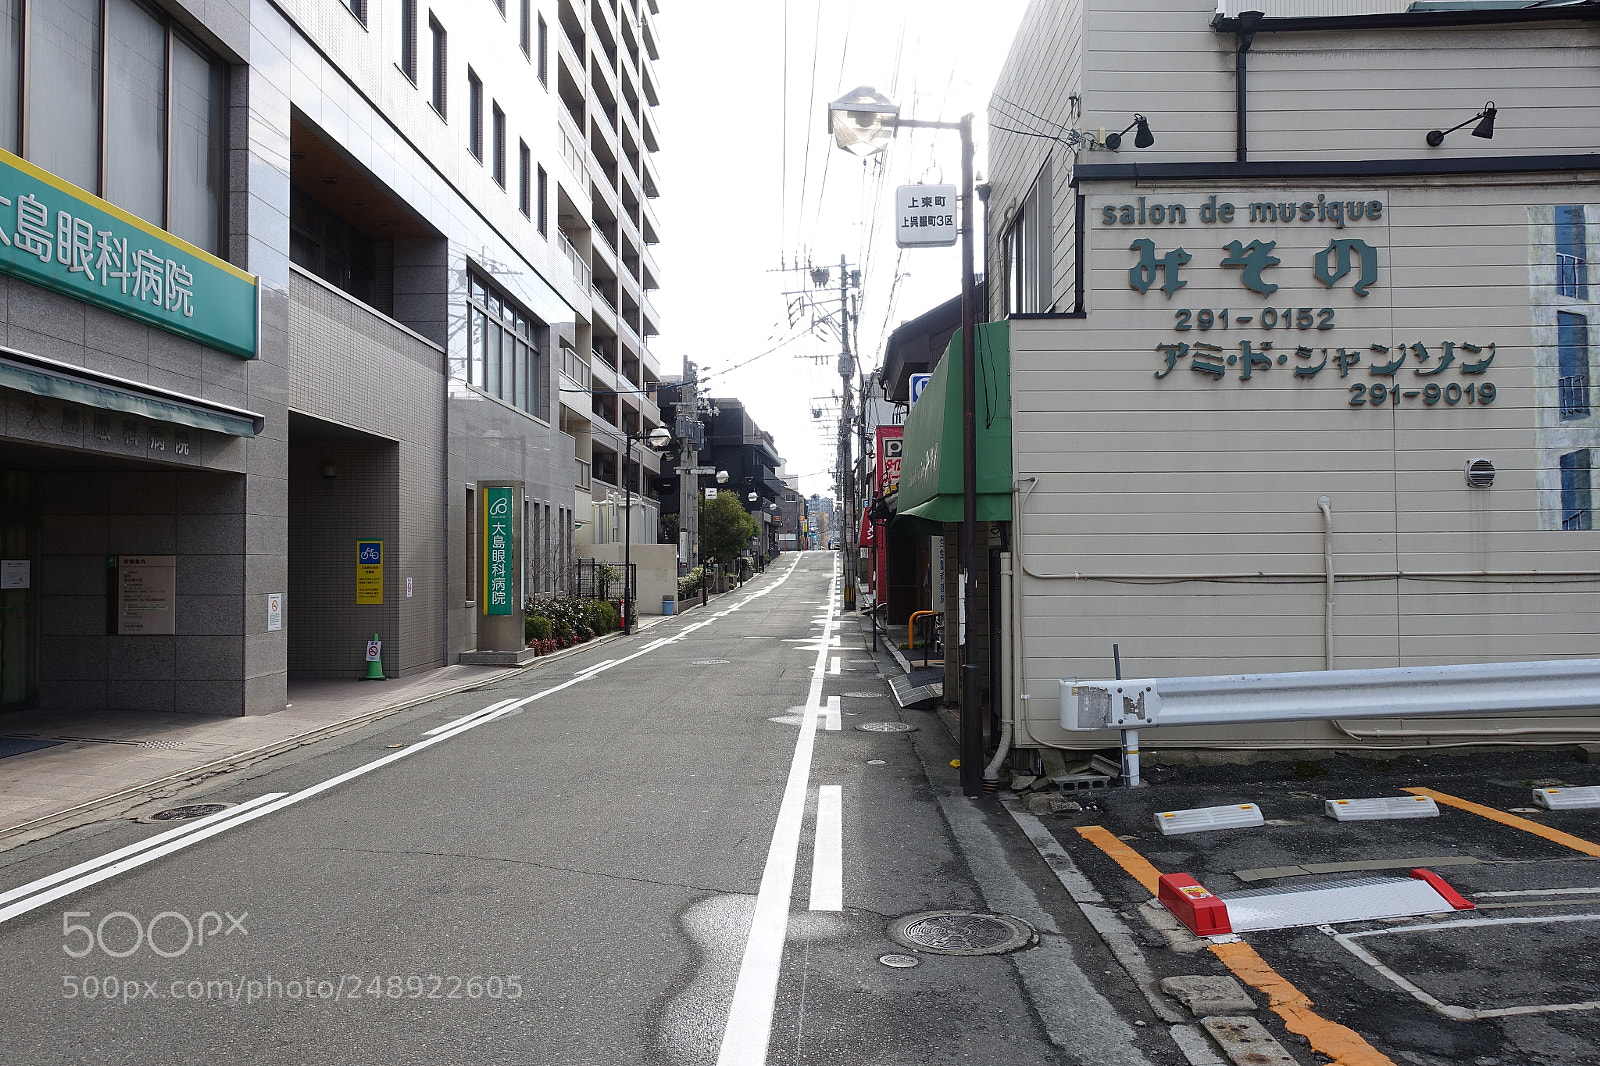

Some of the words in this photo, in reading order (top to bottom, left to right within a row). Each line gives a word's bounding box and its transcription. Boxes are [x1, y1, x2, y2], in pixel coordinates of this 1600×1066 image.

[908, 196, 946, 208] 上東町
[1102, 196, 1187, 225] salon
[1199, 195, 1236, 224] de
[1250, 193, 1383, 230] musique
[0, 193, 194, 318] 島眼科病院
[1128, 238, 1379, 300] みその
[1349, 382, 1497, 406] 291-9019
[887, 441, 902, 456] P
[491, 521, 506, 605] 大島眼科病院
